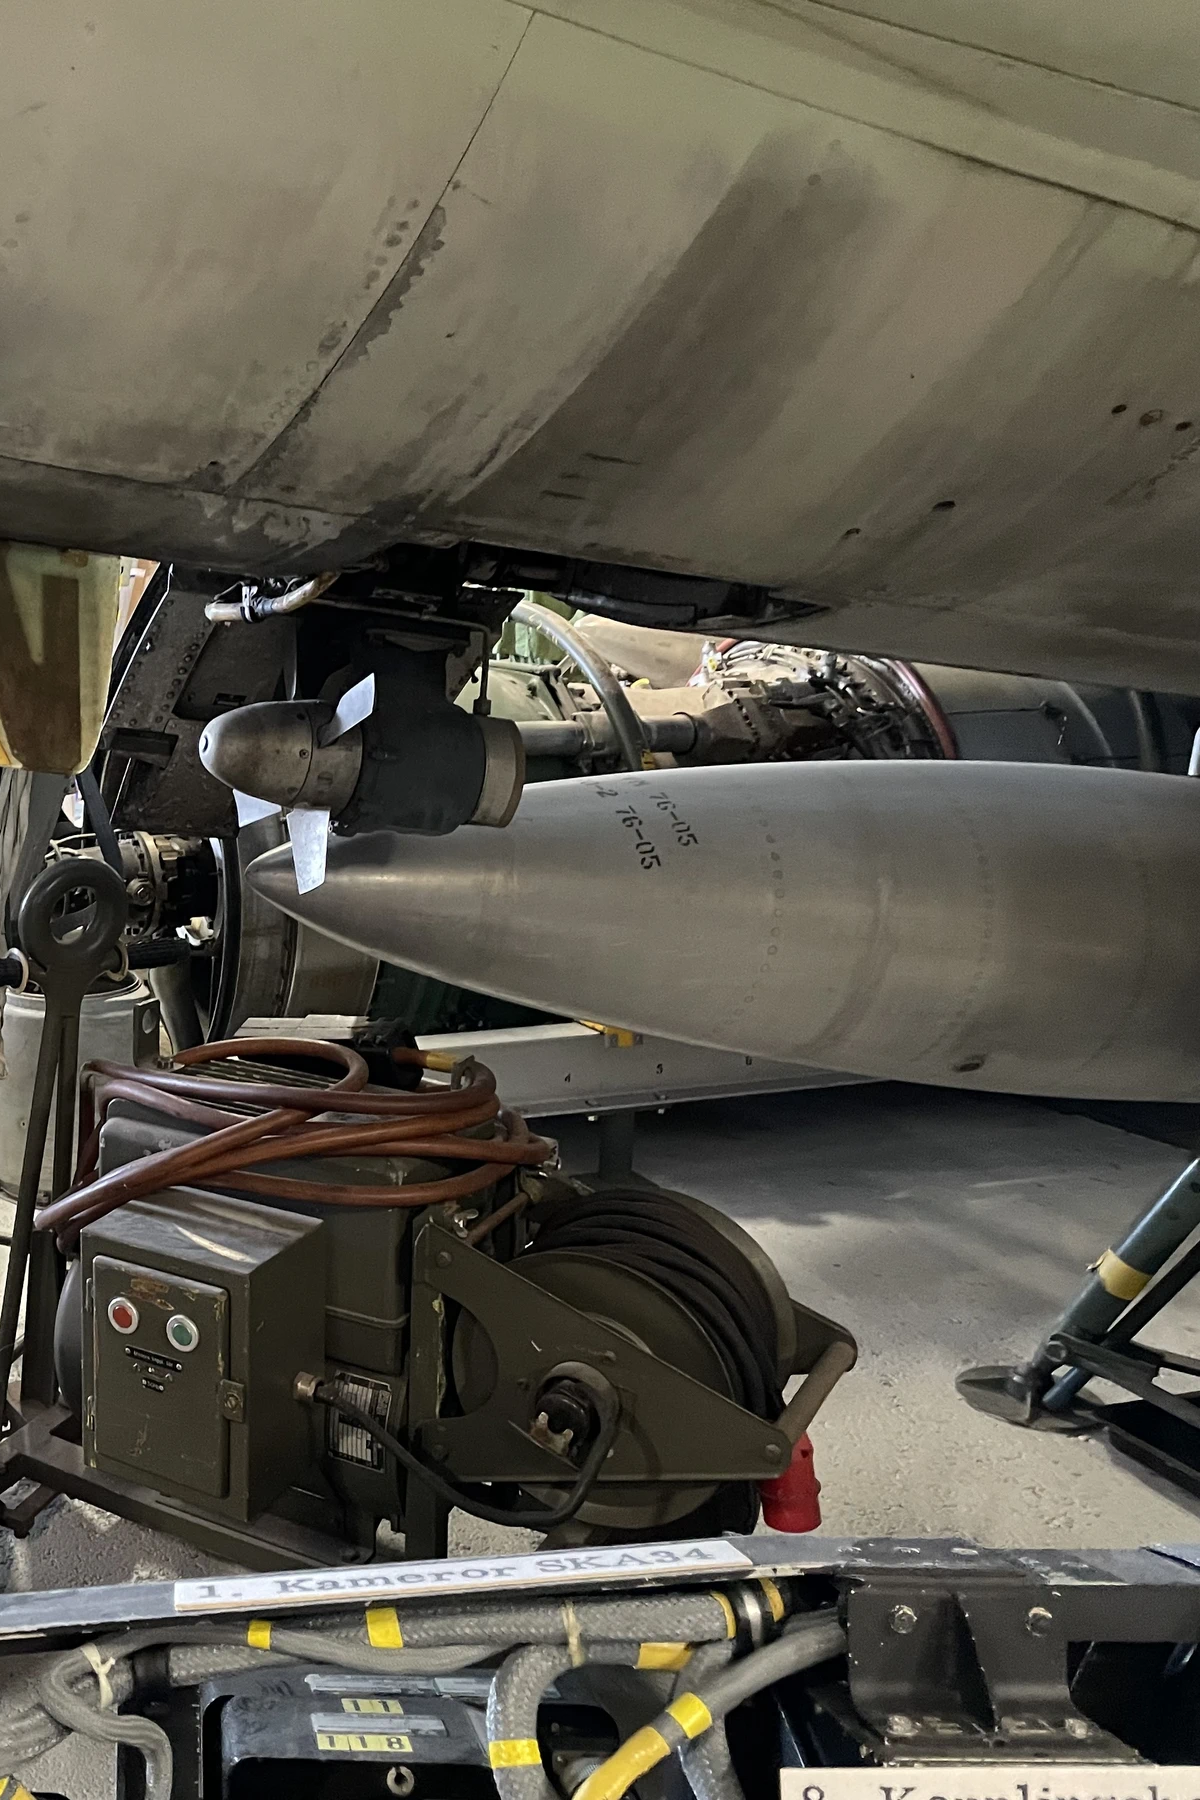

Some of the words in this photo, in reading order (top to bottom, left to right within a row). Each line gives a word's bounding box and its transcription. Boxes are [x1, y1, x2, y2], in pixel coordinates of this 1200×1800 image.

[615, 805, 661, 869] 76-05
[649, 792, 698, 846] 76-05
[196, 1584, 243, 1599] 1.
[273, 1566, 517, 1595] Kameror
[535, 1547, 716, 1573] SKA34
